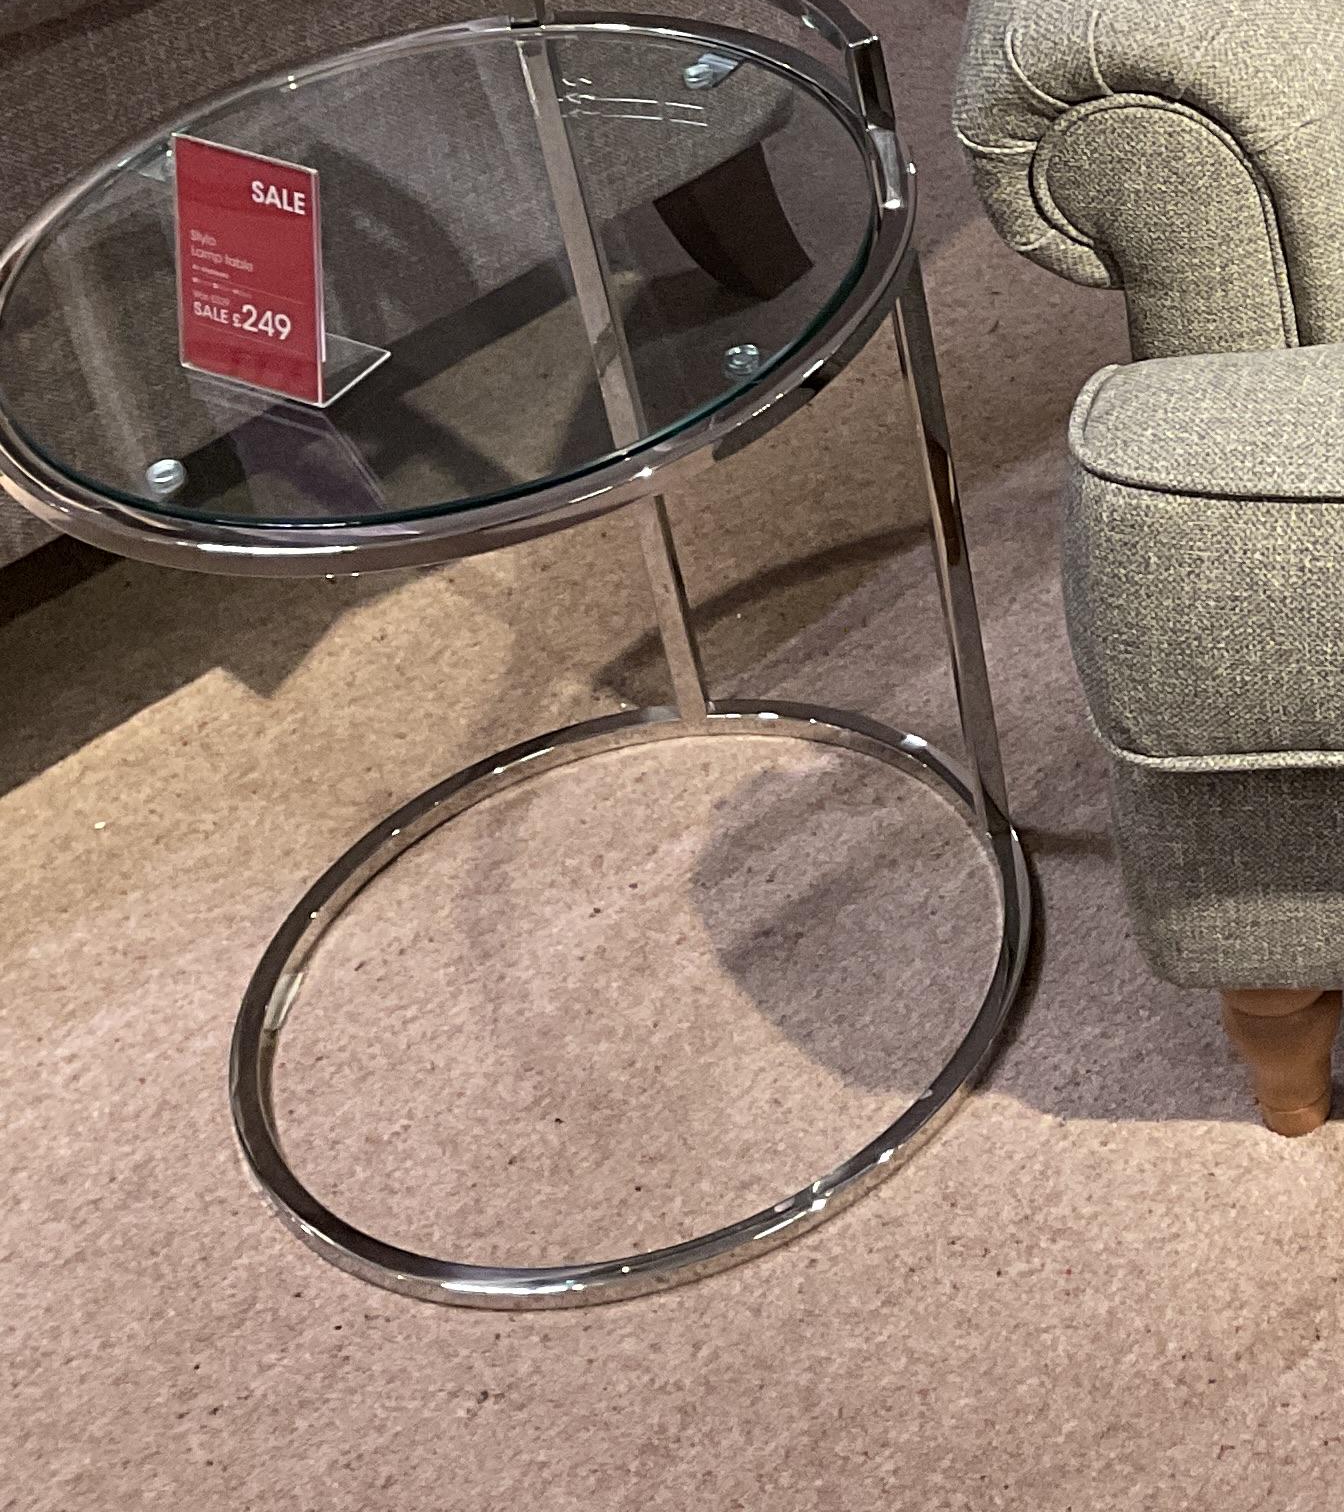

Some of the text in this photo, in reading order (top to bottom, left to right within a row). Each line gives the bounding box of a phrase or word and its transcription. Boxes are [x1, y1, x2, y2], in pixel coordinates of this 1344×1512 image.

[251, 179, 306, 216] SALE
[190, 244, 223, 265] Lamp
[224, 254, 254, 273] table
[193, 300, 292, 341] SALE £249
